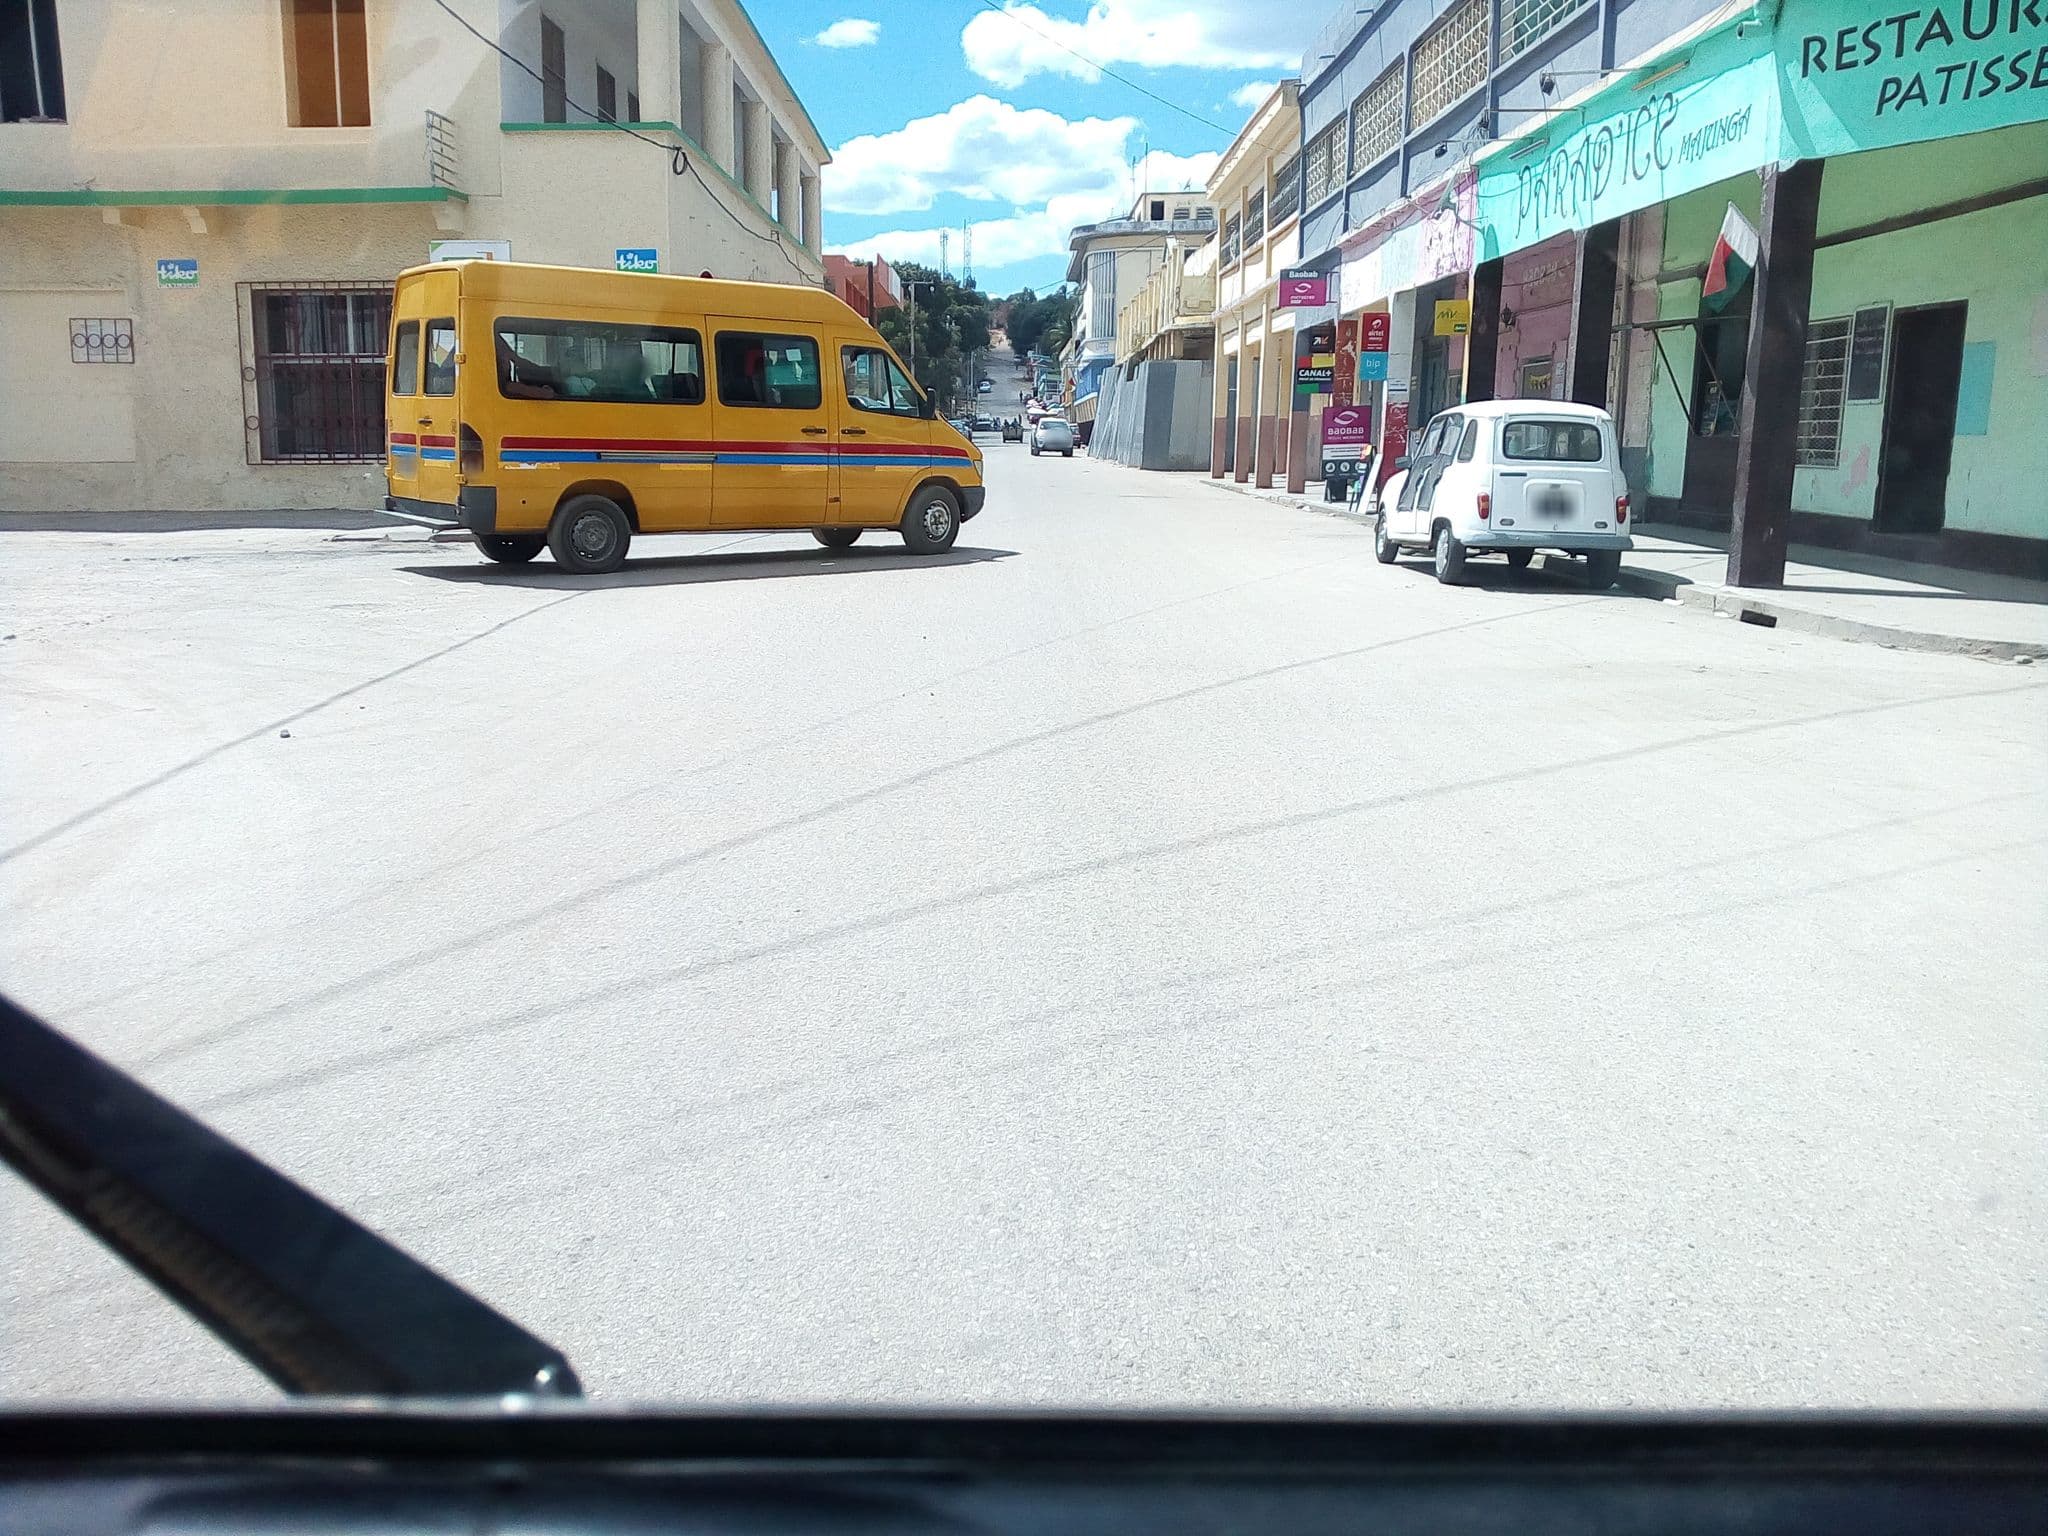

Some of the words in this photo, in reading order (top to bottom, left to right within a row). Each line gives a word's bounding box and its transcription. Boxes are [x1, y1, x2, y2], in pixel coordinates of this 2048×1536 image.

[1801, 0, 2048, 78] RESTAUR
[1678, 103, 1753, 165] MAJUNGA
[616, 252, 657, 270] tiko
[158, 262, 198, 280] tiko
[1288, 270, 1319, 278] Baobab
[1298, 369, 1333, 377] CANAL+
